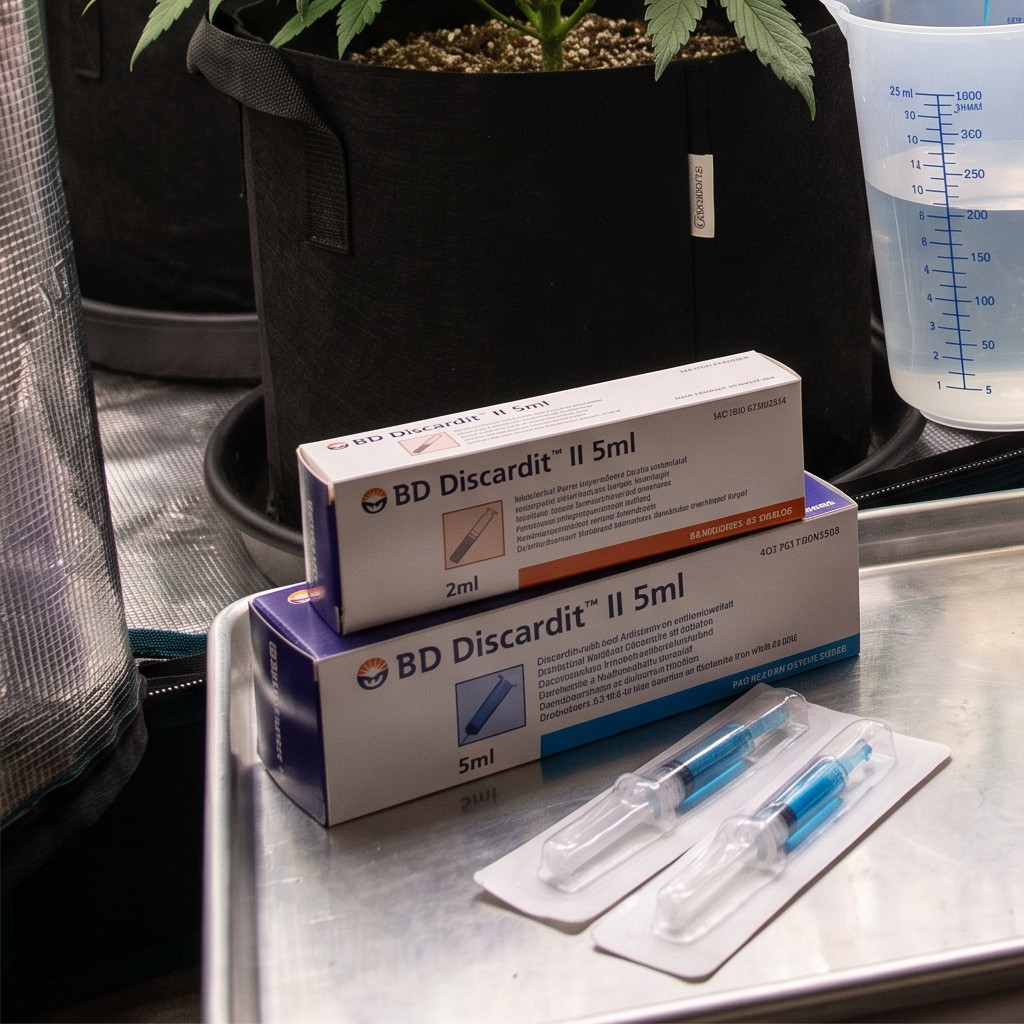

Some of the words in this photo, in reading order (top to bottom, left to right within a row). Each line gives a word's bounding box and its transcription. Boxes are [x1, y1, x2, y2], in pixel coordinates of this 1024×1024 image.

[902, 89, 913, 98] ml
[907, 135, 919, 145] 10
[964, 169, 985, 179] 250
[911, 185, 924, 195] 10
[967, 209, 988, 220] 200
[970, 252, 991, 263] 150
[924, 265, 930, 275] 4
[927, 293, 933, 303] 4
[975, 296, 995, 306] 100
[930, 321, 936, 331] 3
[982, 340, 995, 350] 50
[933, 351, 939, 360] 2
[986, 385, 992, 394] 5
[352, 433, 384, 446] BD
[511, 400, 550, 414] 5ml
[393, 479, 431, 507] BD
[592, 431, 636, 462] 5ml
[446, 575, 479, 598] 2ml
[396, 645, 442, 680] BD
[633, 571, 686, 612] 5ml
[458, 747, 495, 774] 5ml
